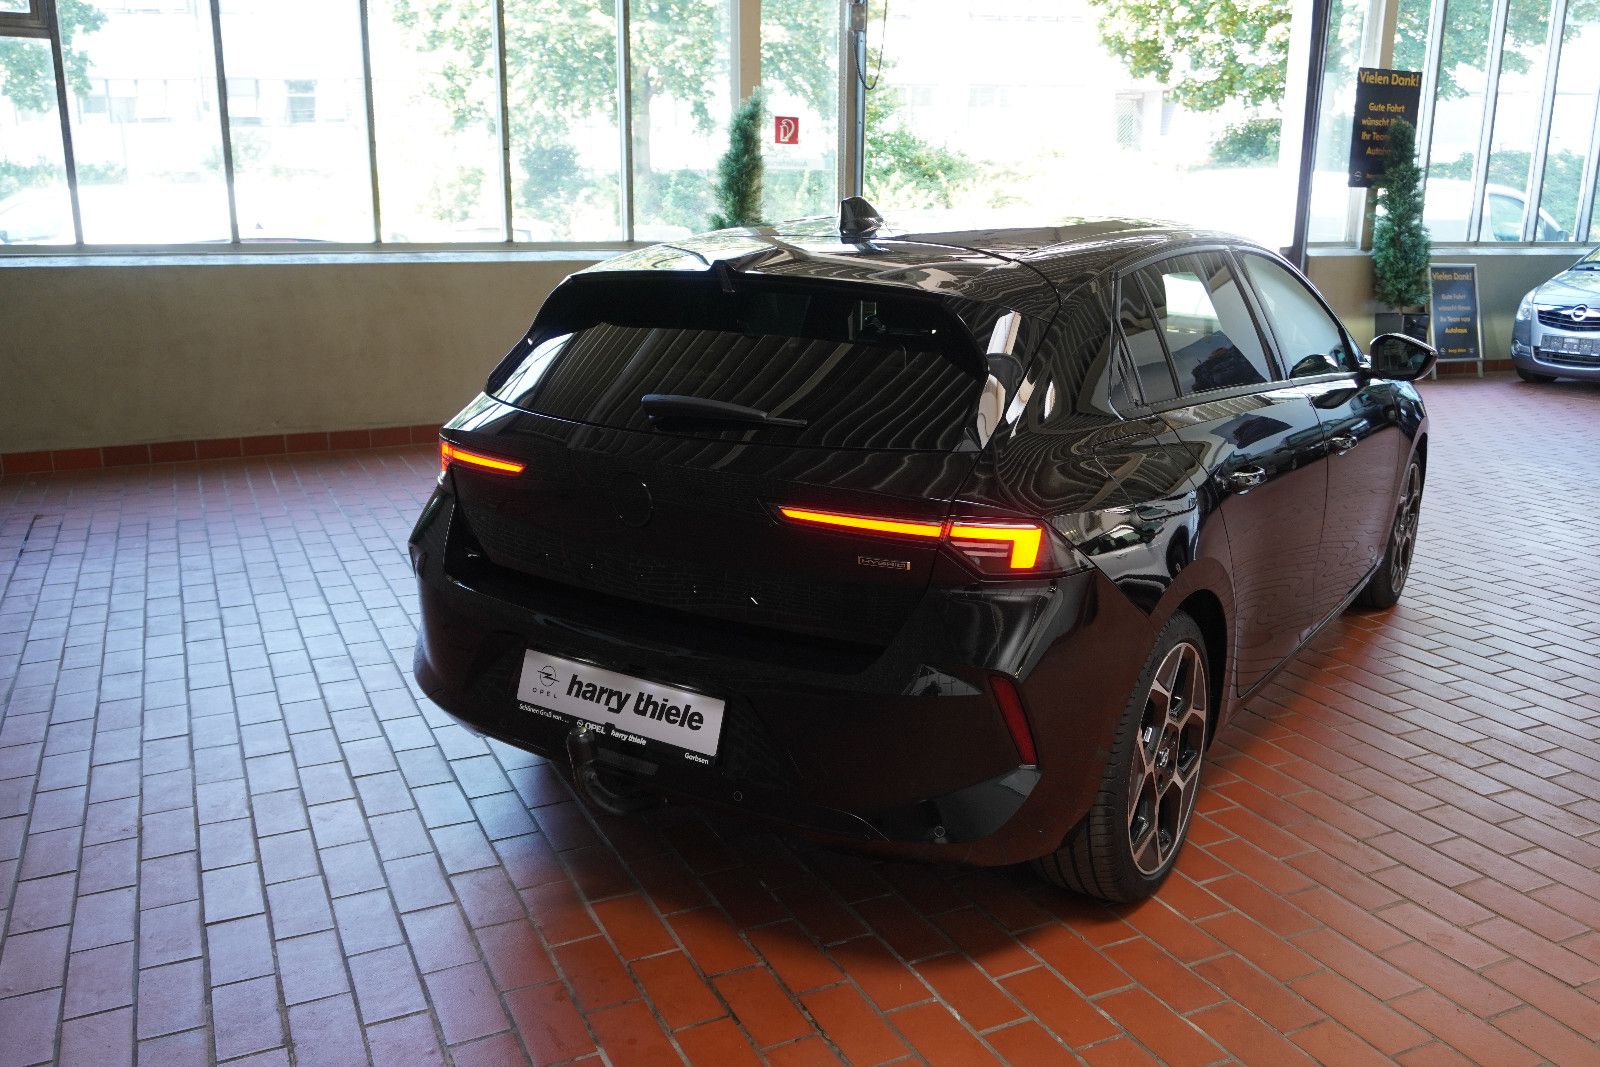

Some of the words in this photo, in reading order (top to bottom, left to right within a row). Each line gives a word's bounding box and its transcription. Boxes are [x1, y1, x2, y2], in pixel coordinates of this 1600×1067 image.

[1360, 71, 1389, 84] Vielen
[1391, 74, 1419, 86] Dank!
[1368, 102, 1385, 112] Gute
[1386, 103, 1405, 113] Fahrt
[1432, 272, 1452, 280] Vielen
[1454, 272, 1472, 280] Dank!
[860, 557, 907, 569] HYBRID
[532, 687, 557, 699] OPEL
[566, 674, 631, 714] harry
[633, 692, 704, 730] thiele
[519, 703, 539, 714] Schönen
[585, 722, 606, 735] OPEL
[611, 729, 628, 741] harry
[628, 734, 647, 746] thiele
